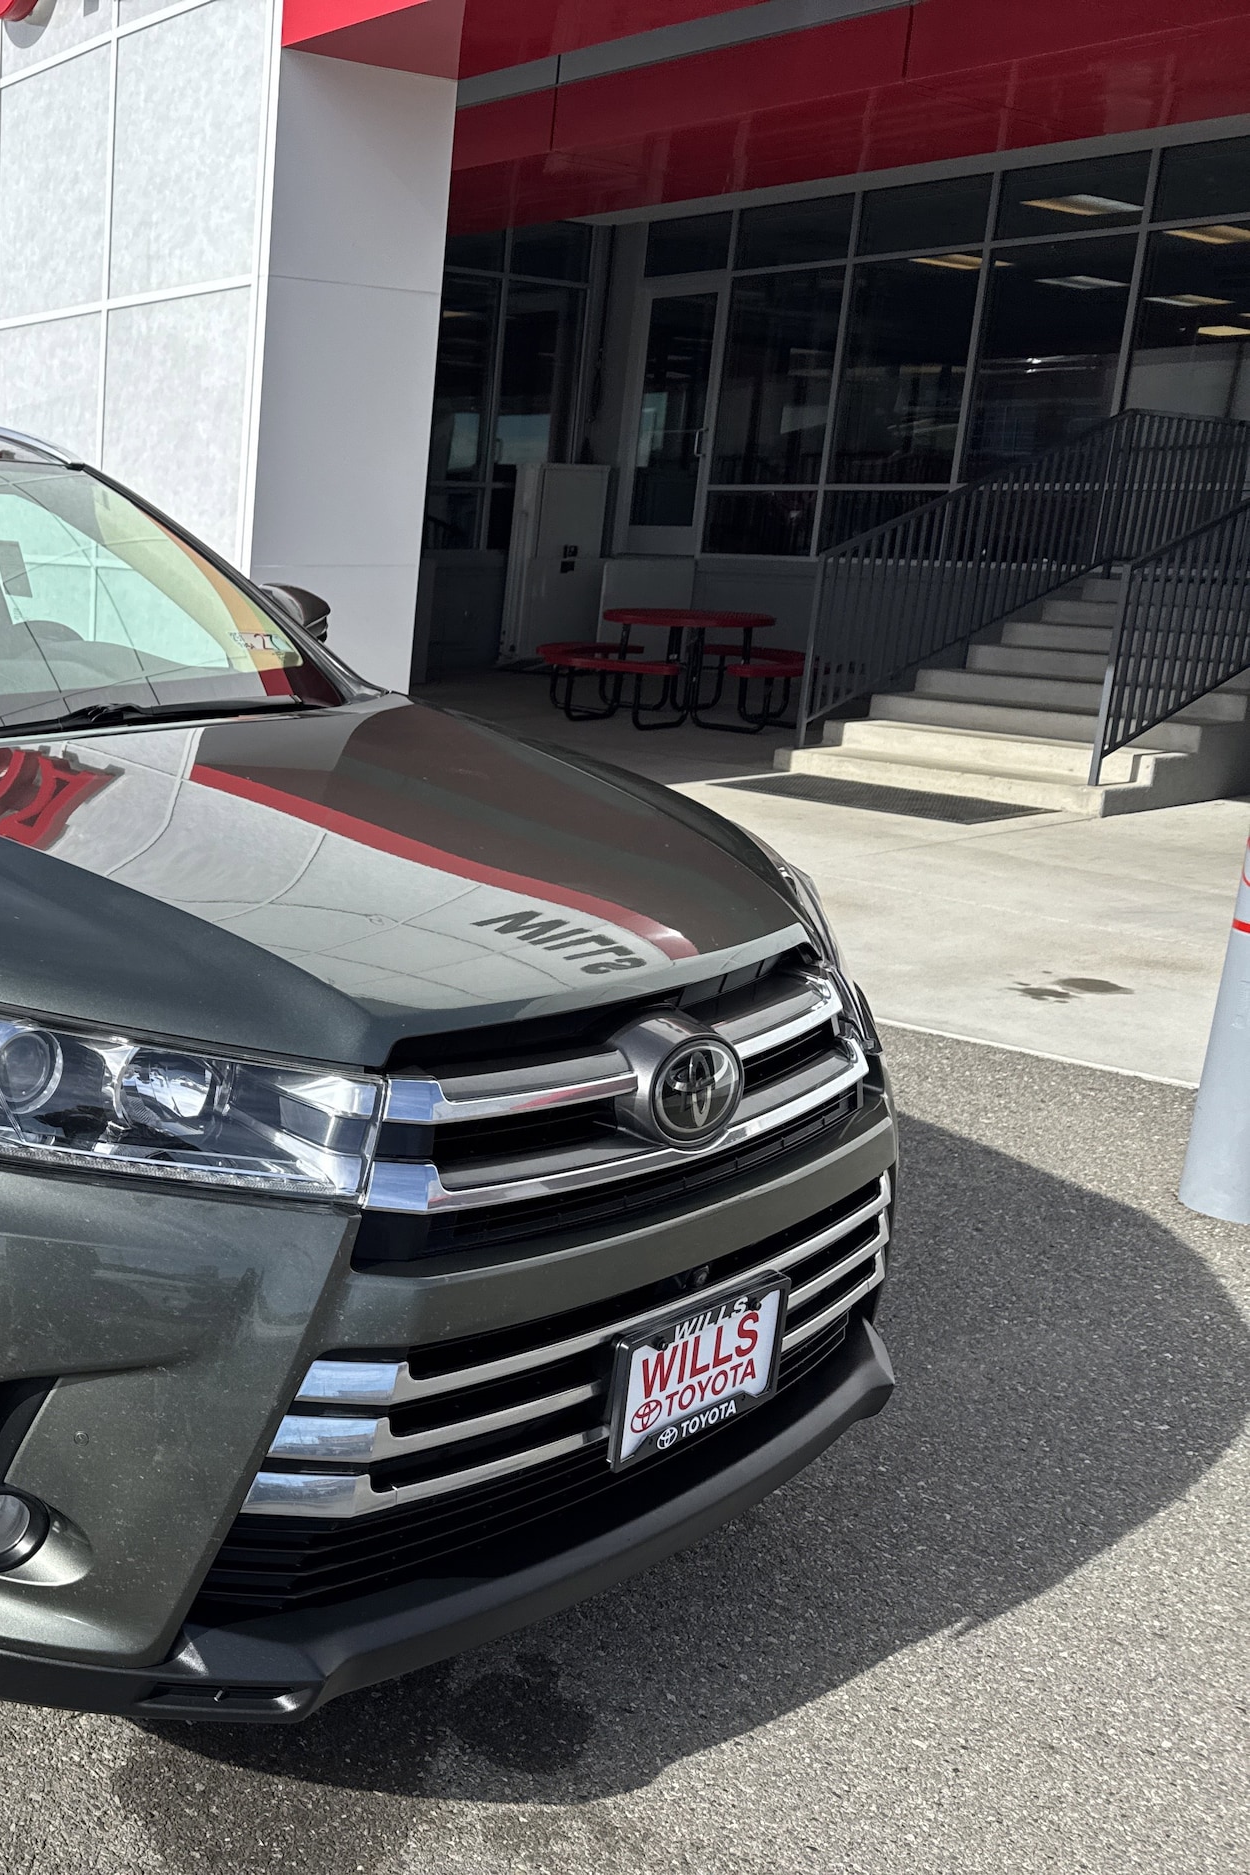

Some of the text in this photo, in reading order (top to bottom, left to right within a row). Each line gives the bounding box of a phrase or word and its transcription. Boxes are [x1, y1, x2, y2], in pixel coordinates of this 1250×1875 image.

[675, 1296, 748, 1342] WILLS
[642, 1312, 759, 1399] WILLS
[665, 1358, 756, 1416] TOYOTA
[681, 1400, 737, 1438] TOYOTA
